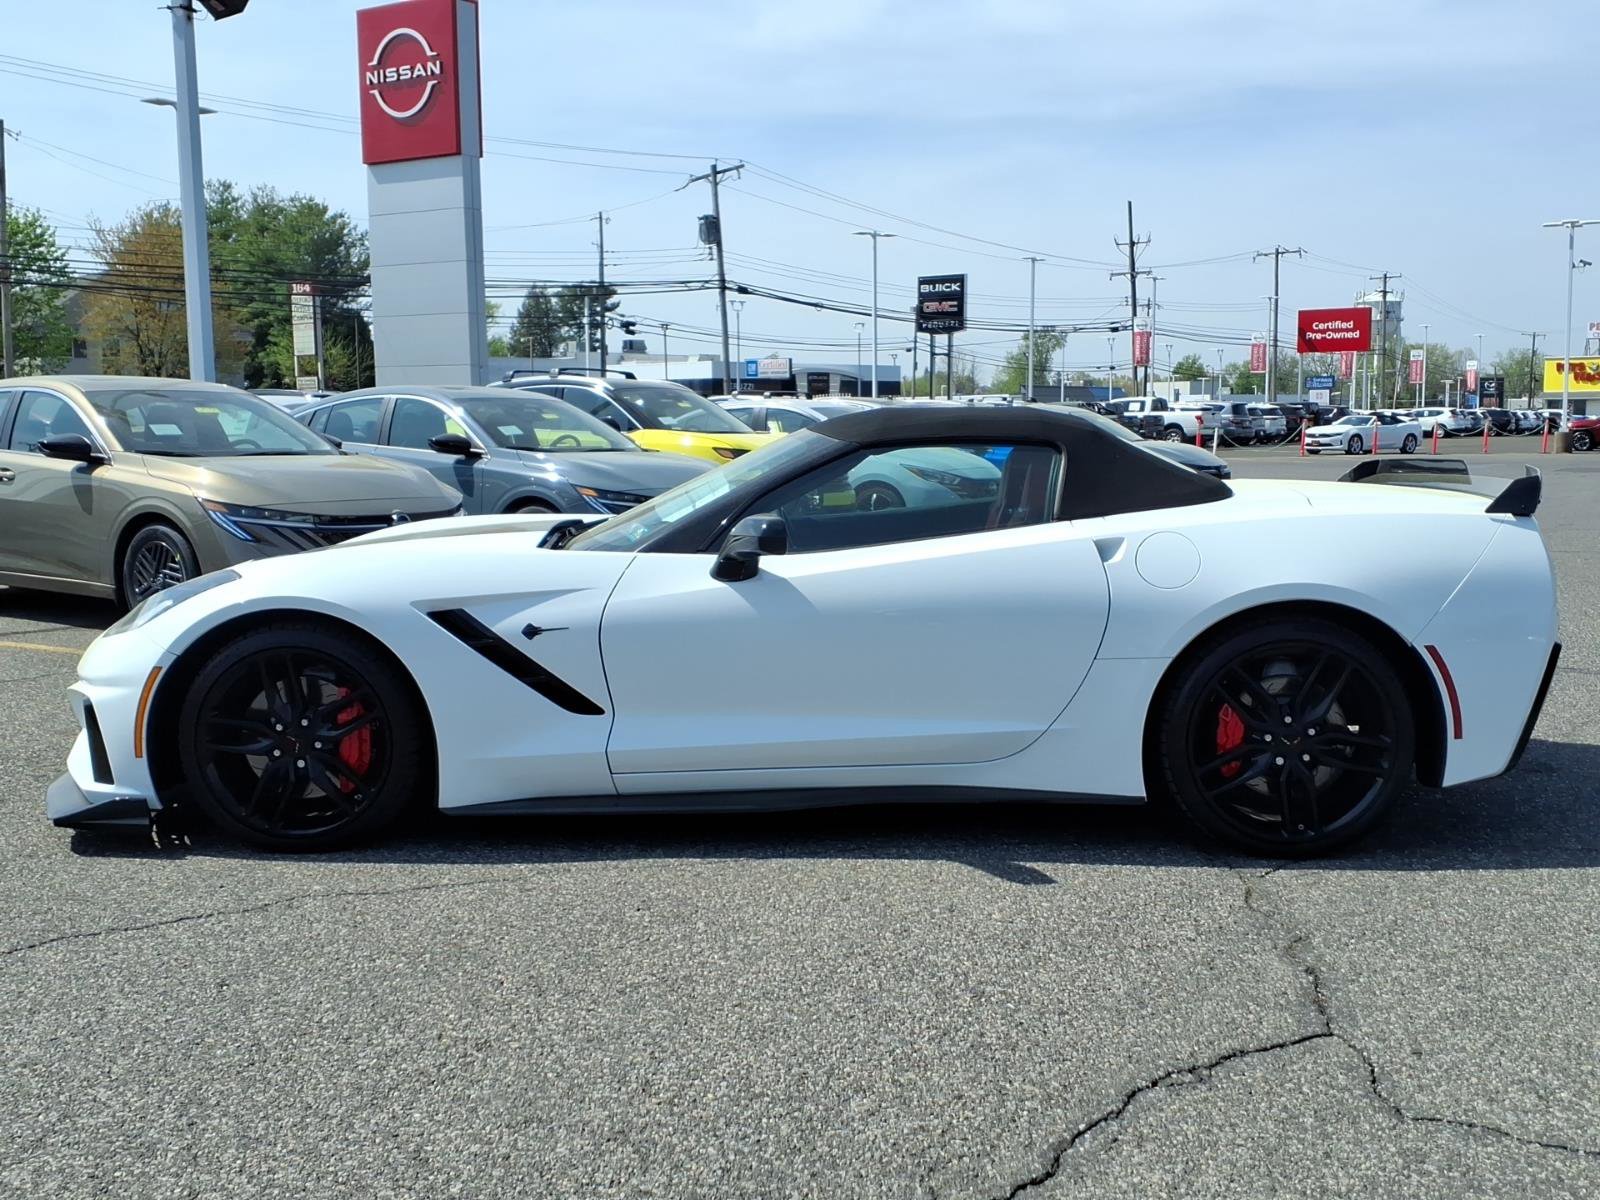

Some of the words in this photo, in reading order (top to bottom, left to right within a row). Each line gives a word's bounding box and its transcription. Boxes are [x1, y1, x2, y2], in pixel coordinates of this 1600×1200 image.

[366, 61, 440, 85] NISSAN
[292, 283, 311, 293] 164
[920, 282, 961, 292] BUICK
[923, 301, 958, 312] GMC
[1312, 320, 1354, 330] Certified
[1306, 330, 1360, 340] Pre-Owned
